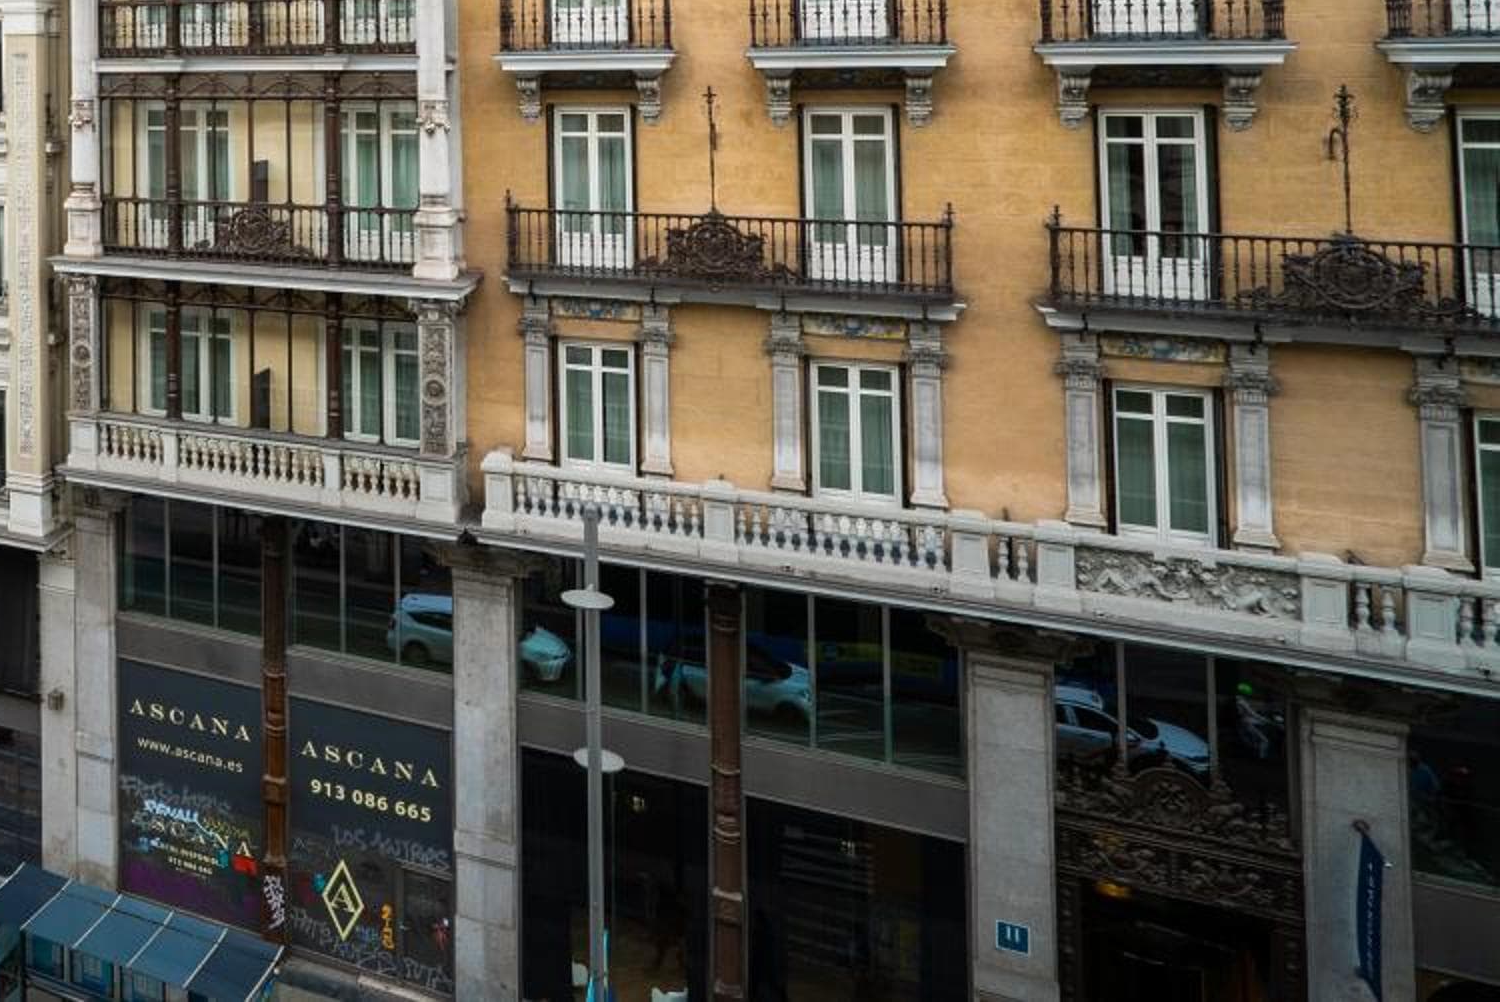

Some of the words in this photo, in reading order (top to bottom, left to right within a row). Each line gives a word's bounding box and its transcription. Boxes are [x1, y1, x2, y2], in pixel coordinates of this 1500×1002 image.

[129, 698, 251, 742] ASCANA
[137, 737, 243, 773] www.ascana.es
[300, 740, 440, 788] ASCANA
[310, 779, 345, 800] 913
[352, 789, 388, 811] 086
[395, 801, 432, 823] 665
[331, 882, 356, 913] A
